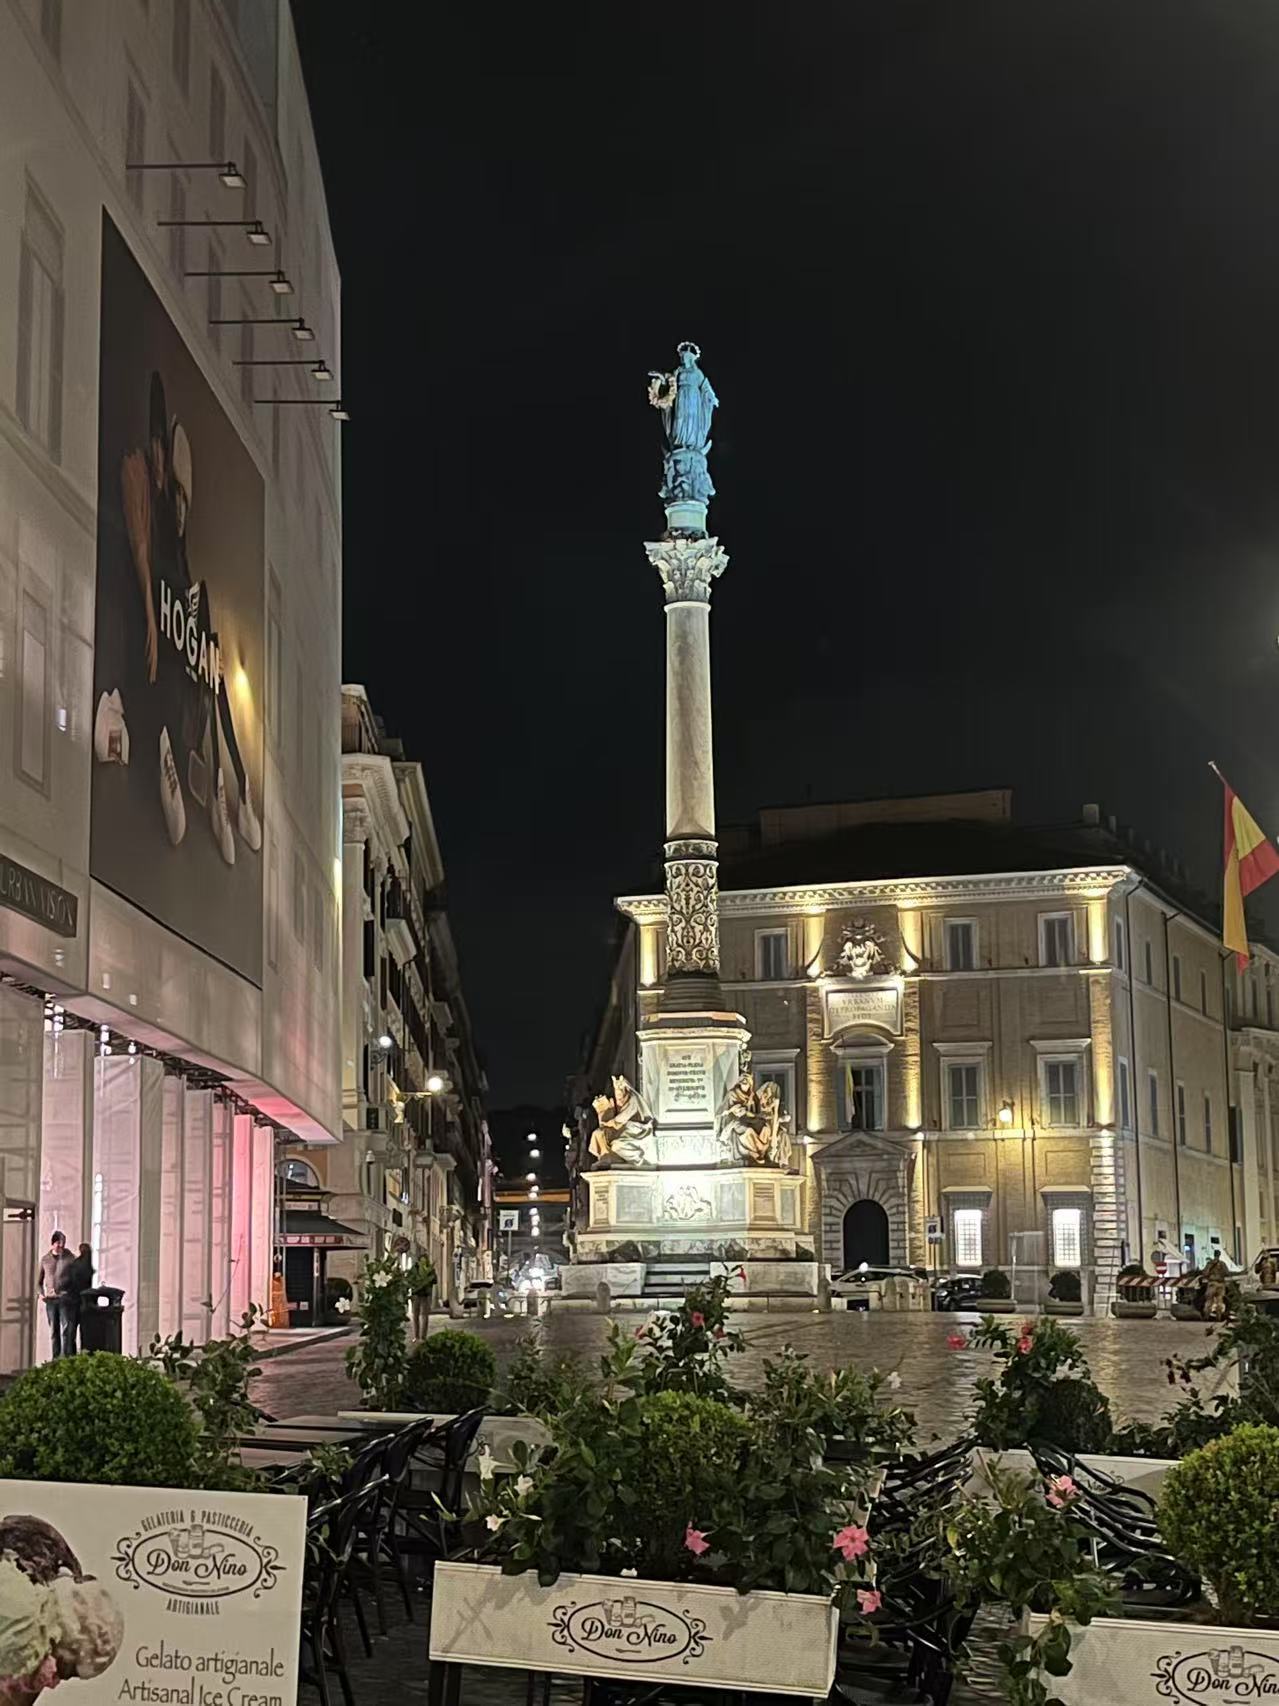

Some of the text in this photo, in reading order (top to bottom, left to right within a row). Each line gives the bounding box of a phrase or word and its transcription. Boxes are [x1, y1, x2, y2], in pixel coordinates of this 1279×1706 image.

[160, 579, 220, 695] HOGAN
[141, 1509, 185, 1532] GELATERIA
[201, 1510, 255, 1538] PASTICCERIA
[146, 1548, 248, 1580] Don Nino
[166, 1598, 220, 1615] ARTIGIANALE
[580, 1616, 678, 1648] Don Nino
[135, 1639, 285, 1685] Gelato artigianale
[118, 1675, 283, 1706] Artisanal Ice Cream
[1186, 1667, 1279, 1698] Don Nin
